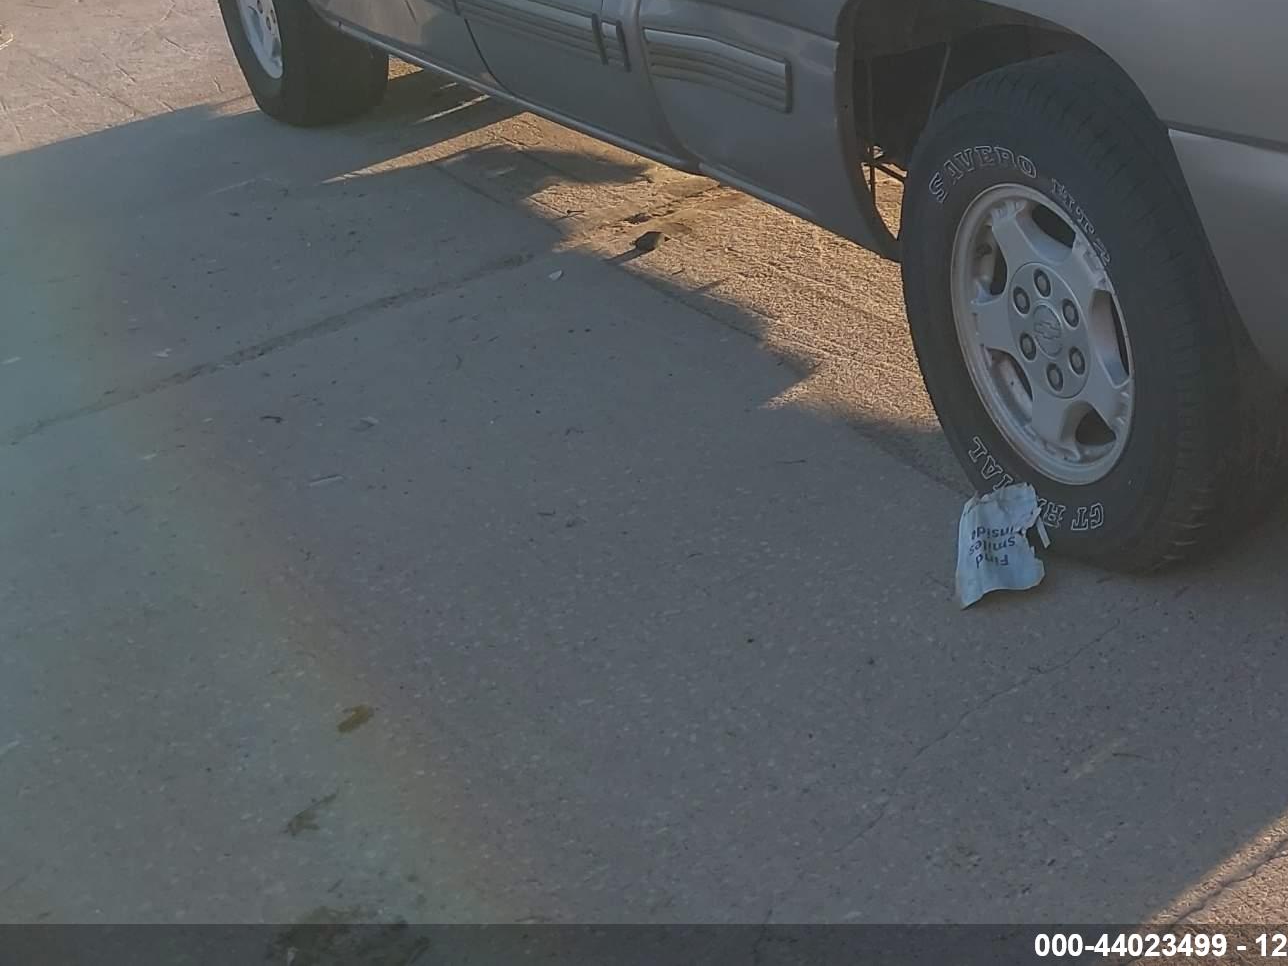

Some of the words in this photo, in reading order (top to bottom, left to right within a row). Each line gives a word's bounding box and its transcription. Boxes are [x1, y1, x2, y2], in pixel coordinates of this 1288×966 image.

[928, 145, 1037, 204] SAVERO
[1070, 502, 1104, 531] GT
[975, 553, 1009, 569] Find
